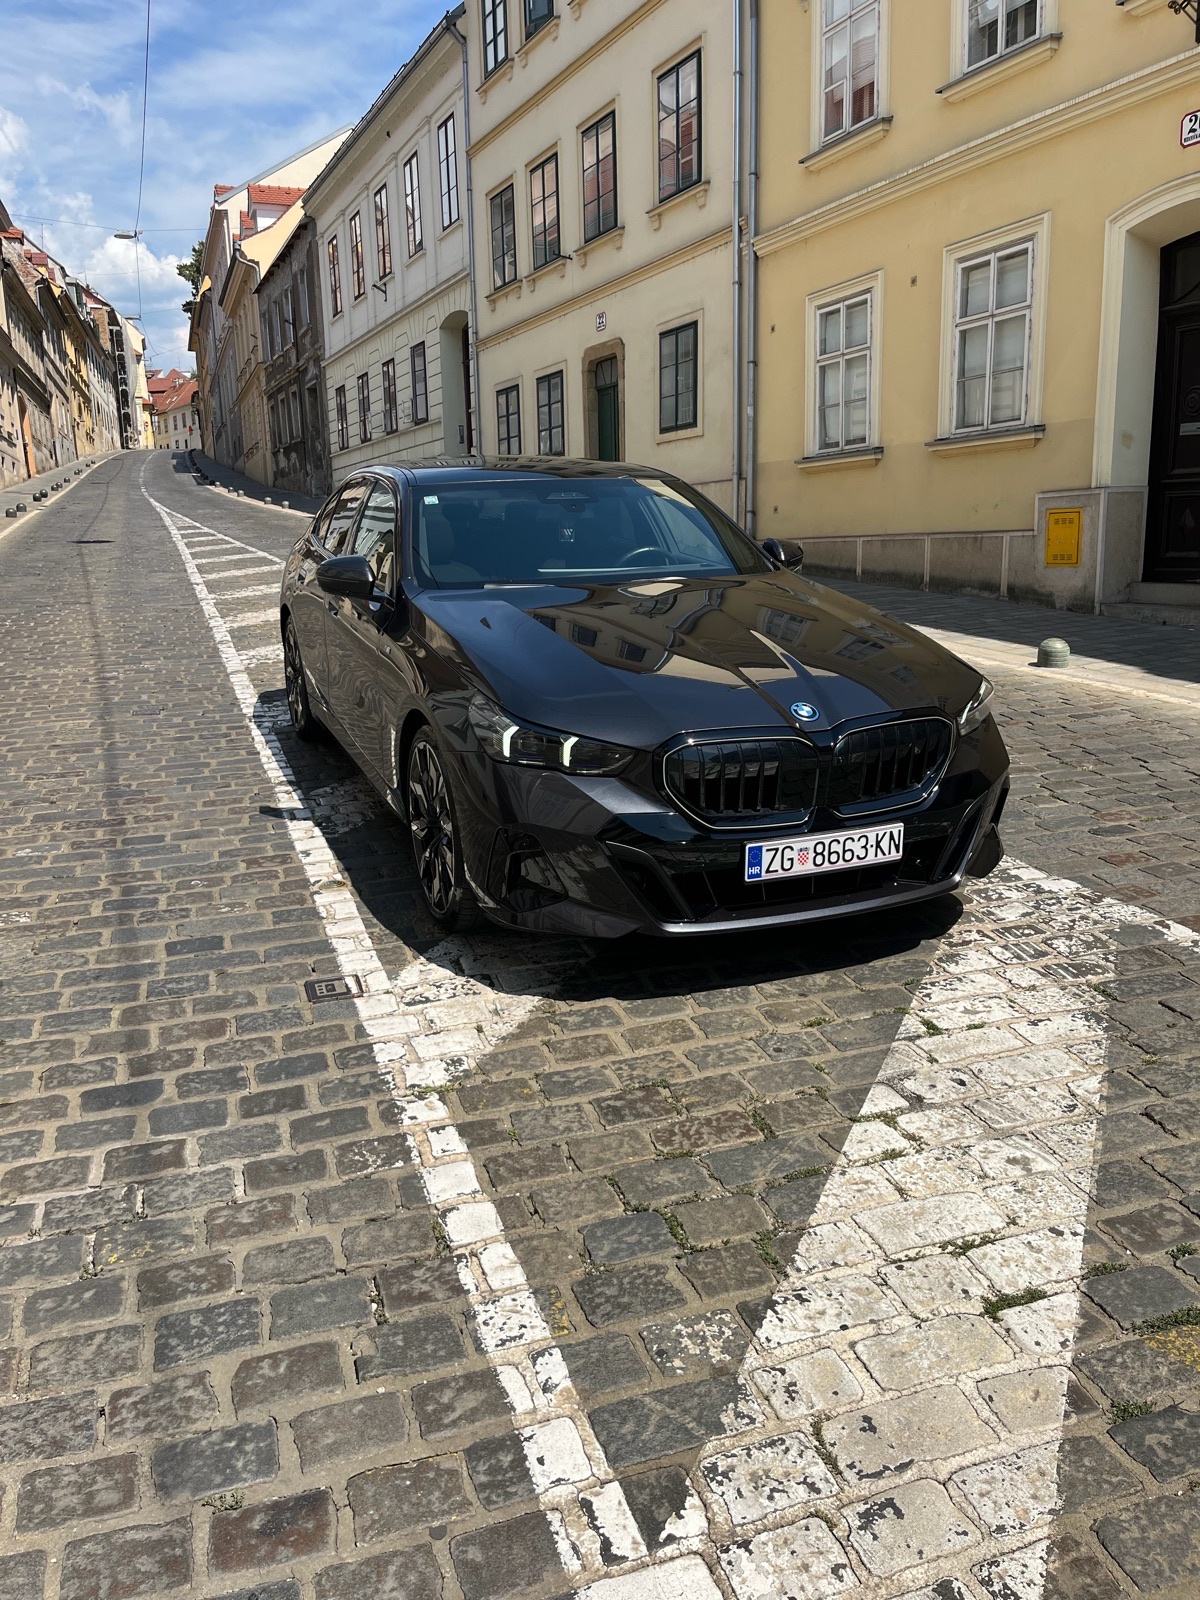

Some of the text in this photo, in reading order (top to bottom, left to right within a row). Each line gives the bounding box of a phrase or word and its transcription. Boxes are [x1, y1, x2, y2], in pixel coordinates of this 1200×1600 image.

[1187, 114, 1200, 135] 2
[748, 866, 761, 875] HR
[765, 846, 794, 874] ZG
